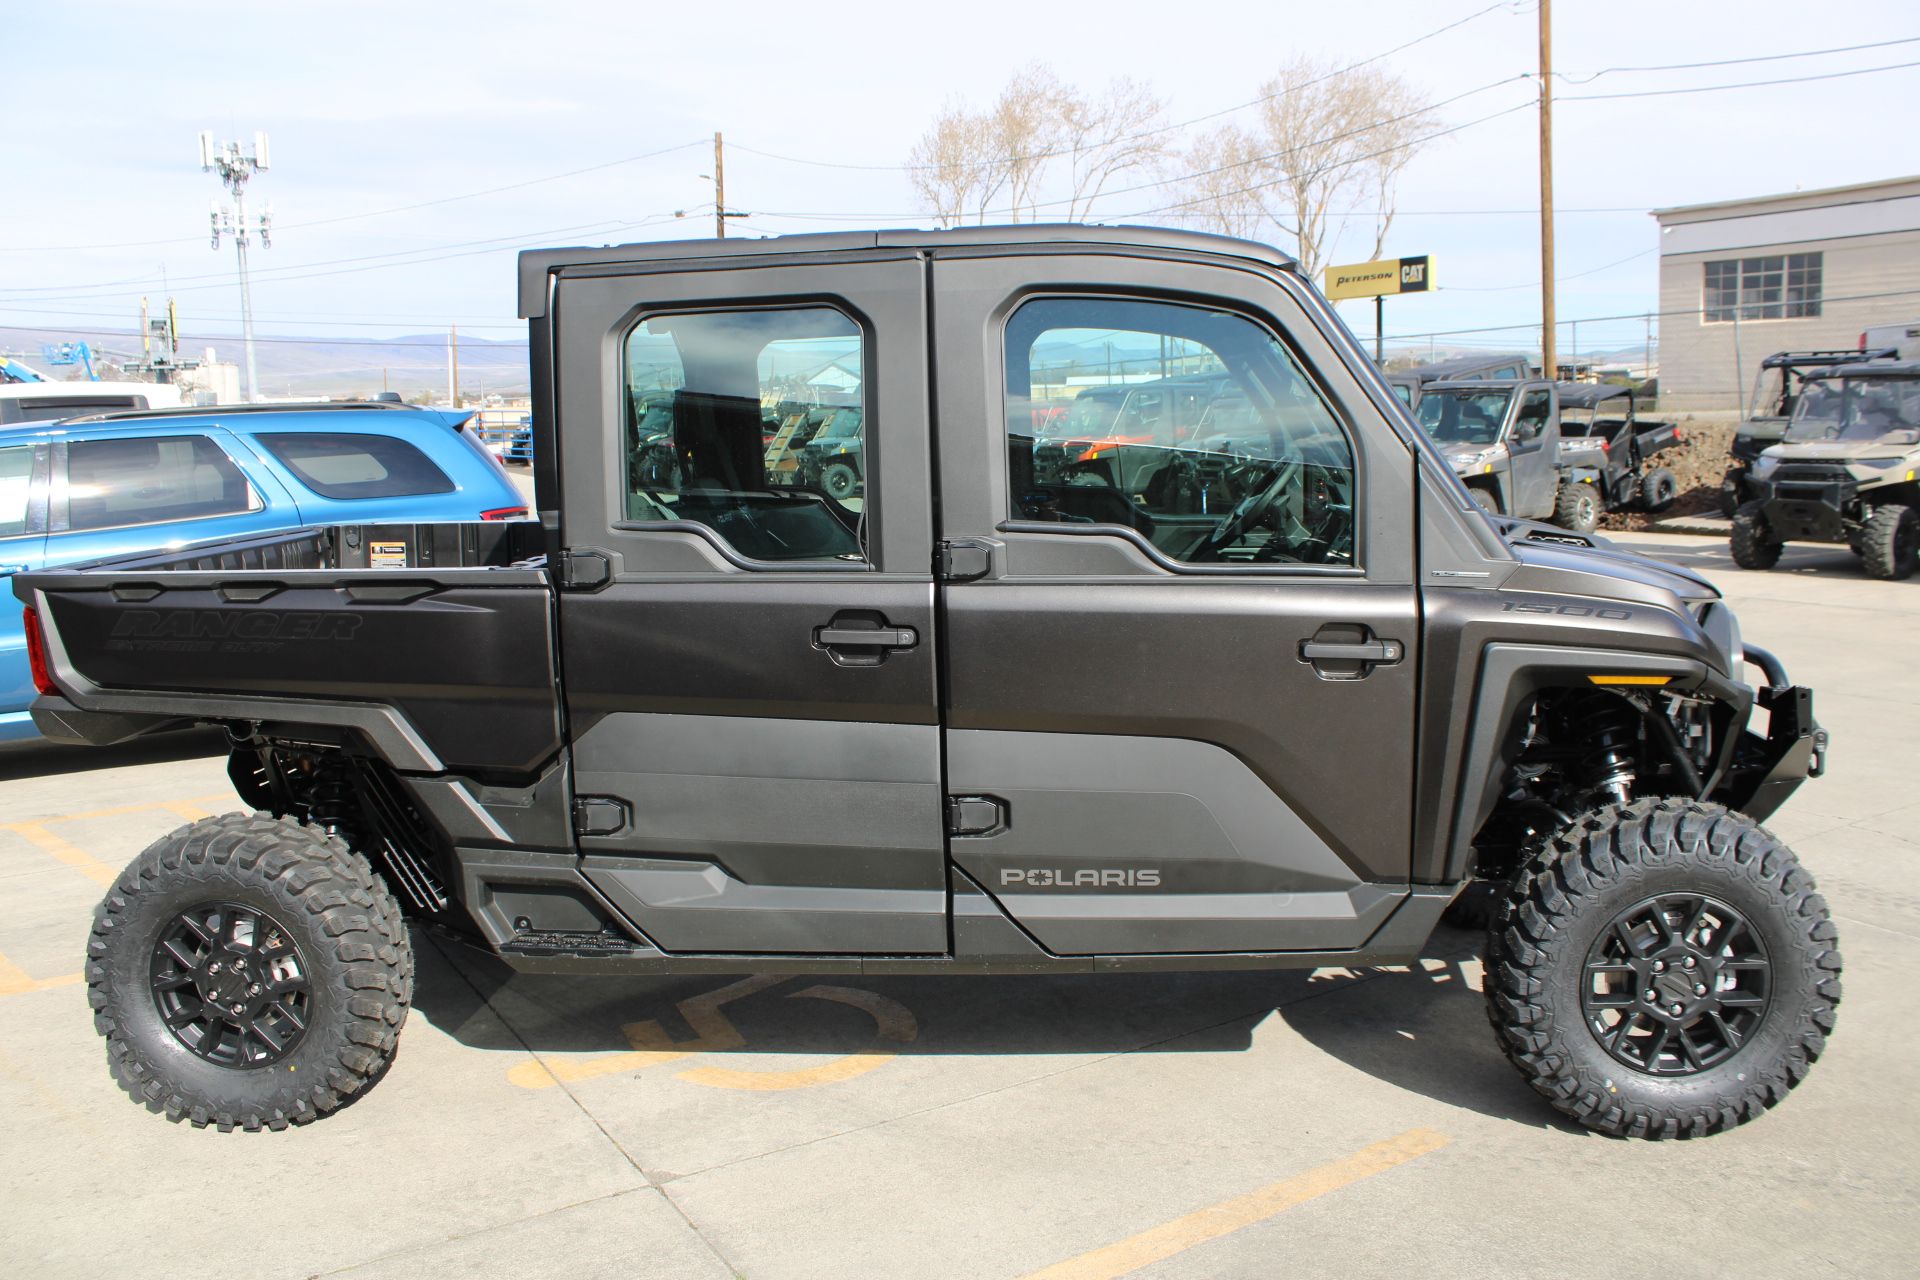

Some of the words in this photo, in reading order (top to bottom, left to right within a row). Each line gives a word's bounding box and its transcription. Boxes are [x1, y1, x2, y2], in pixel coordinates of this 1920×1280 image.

[1336, 272, 1393, 287] PETERSON
[1401, 264, 1425, 283] CAT
[1501, 601, 1633, 621] 1500
[110, 610, 363, 640] RANGER
[1000, 868, 1161, 887] POLARIS
